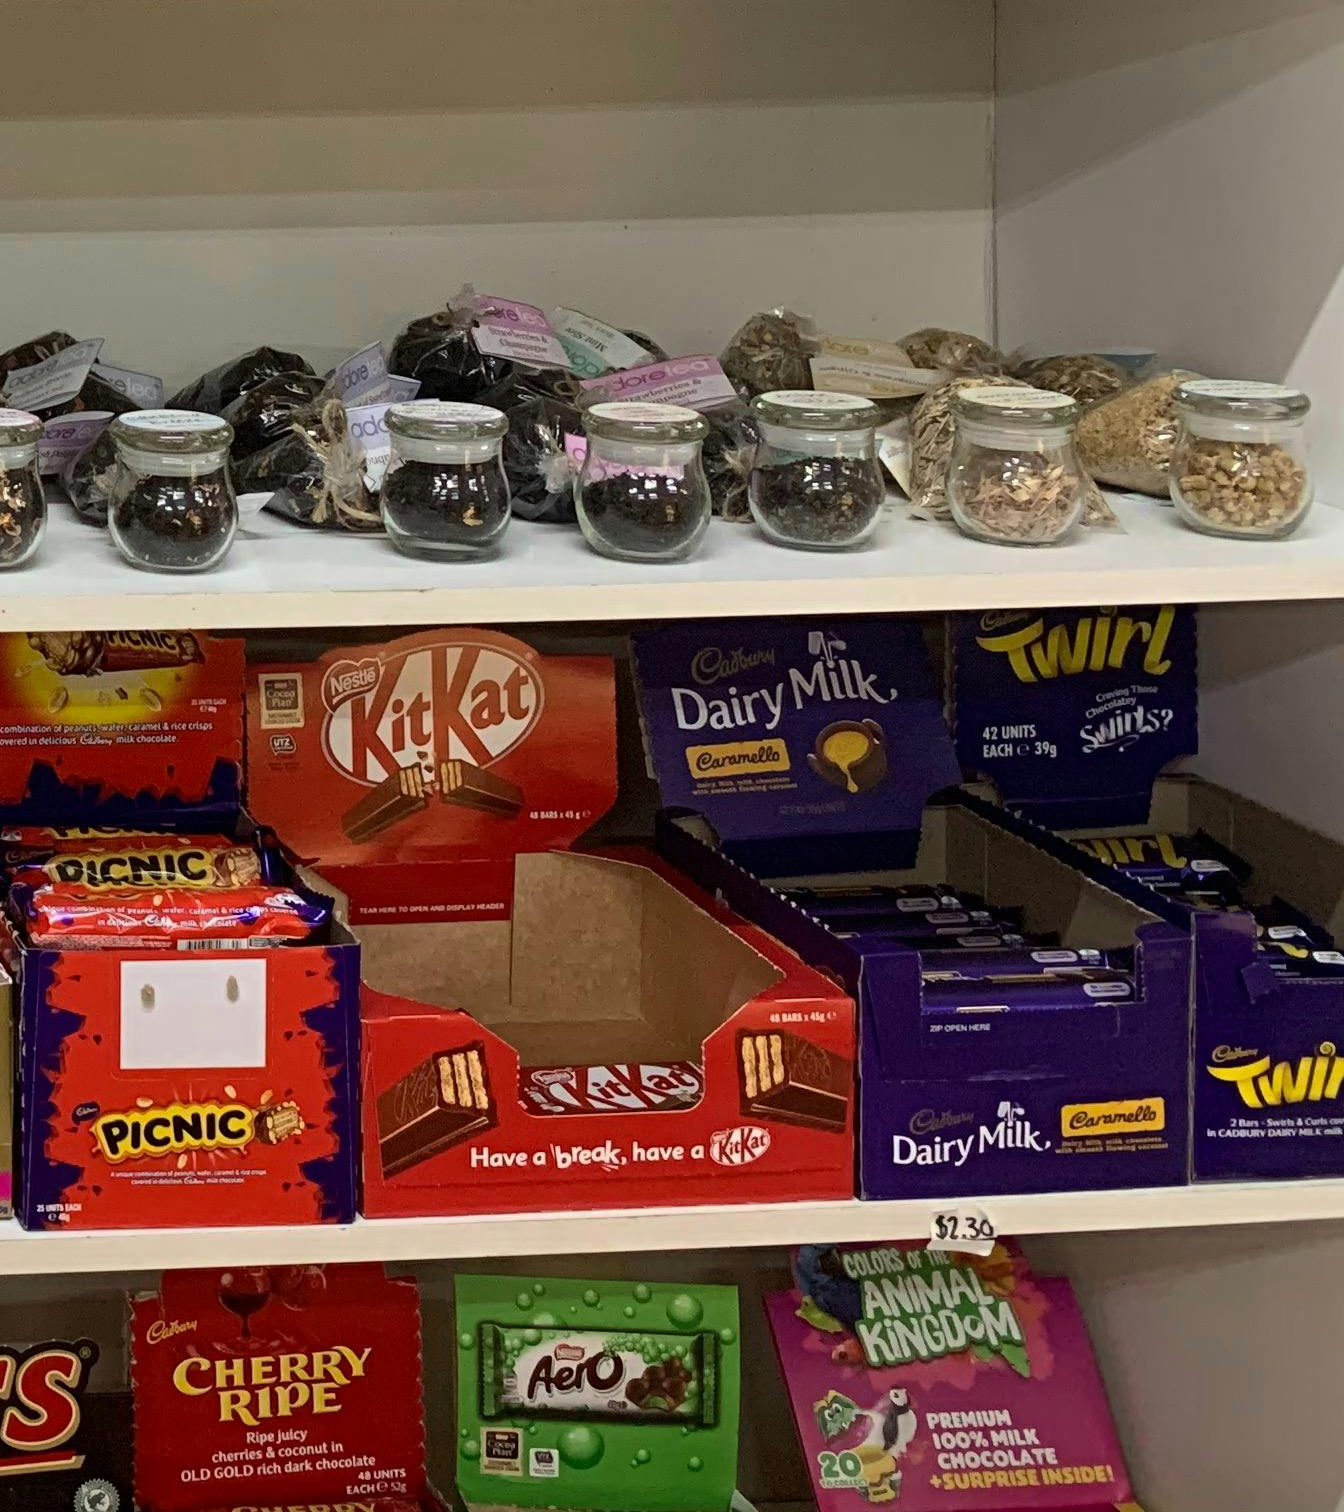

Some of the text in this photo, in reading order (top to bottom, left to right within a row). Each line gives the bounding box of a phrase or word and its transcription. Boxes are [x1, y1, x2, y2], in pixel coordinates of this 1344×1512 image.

[671, 659, 898, 732] Dairy Milk
[351, 647, 531, 779] KitKat
[983, 724, 1037, 741] 42 UNITS
[696, 745, 781, 772] Caramello
[983, 741, 1057, 758] EACH 39g
[54, 851, 212, 887] PICNIC
[782, 1012, 803, 1023] BARS
[930, 1023, 991, 1034] ZIP OPEN HERE
[1069, 1106, 1158, 1131] Caramello
[1239, 1118, 1259, 1127] Bars
[101, 1111, 247, 1155] PICNIC
[893, 1134, 974, 1167] Dairy
[979, 1119, 1051, 1156] Milk
[1218, 1129, 1266, 1138] CADBURY
[1268, 1129, 1296, 1137] DAIRY
[470, 1129, 767, 1172] Have a break, have a KitKat
[934, 1214, 995, 1240] $2.30
[843, 1248, 923, 1279] COLORS OF
[861, 1268, 994, 1319] ANIMAL
[146, 1320, 197, 1344] Cadbury
[859, 1301, 1022, 1363] KINGDOM
[173, 1346, 372, 1396] CHERRY
[218, 1382, 342, 1426] RIPE
[926, 1410, 1012, 1430] PREMIUM
[246, 1429, 307, 1445] Ripe juicy
[932, 1429, 1040, 1450] 100% MILK
[212, 1441, 344, 1464] cherries & coconut in
[818, 1451, 862, 1478] 20
[938, 1448, 1058, 1470] CHOCOLATE
[181, 1455, 376, 1482] OLD GOLD rich dark chocolate
[374, 1468, 406, 1479] UNITS
[1043, 1464, 1114, 1485] INSIDE!
[346, 1485, 375, 1495] EACH
